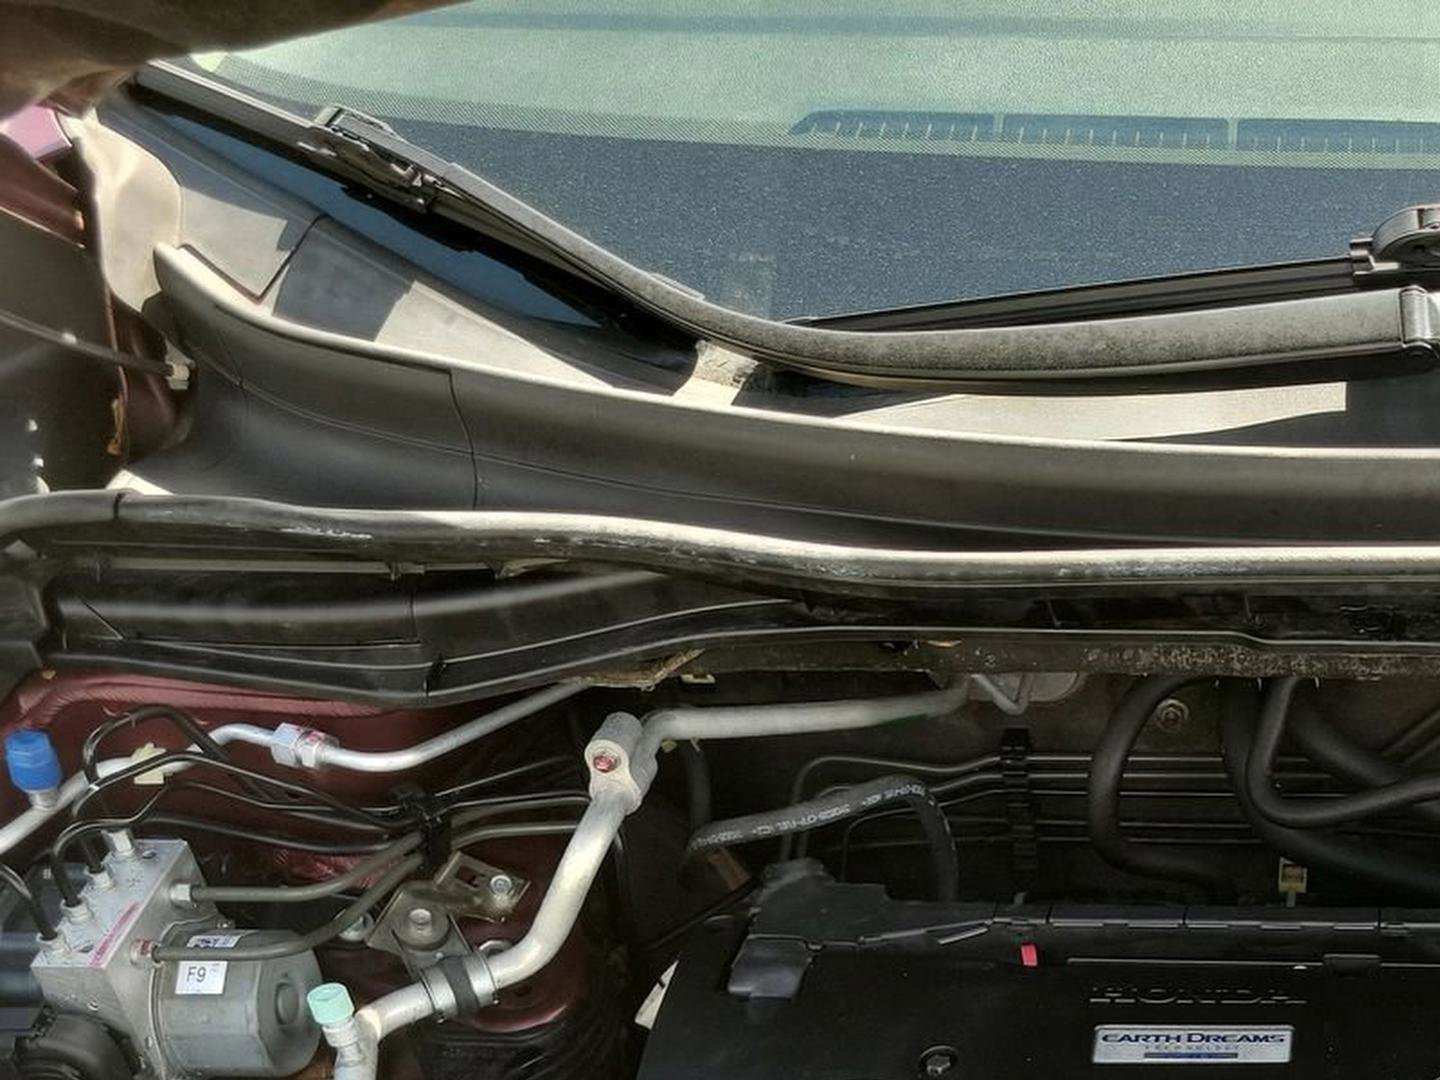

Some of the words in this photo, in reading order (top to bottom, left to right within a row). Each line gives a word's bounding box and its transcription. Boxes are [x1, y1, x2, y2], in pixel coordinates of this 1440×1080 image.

[186, 966, 207, 983] F9
[1102, 1032, 1181, 1044] EARTH
[1186, 1031, 1285, 1044] DREAMS
